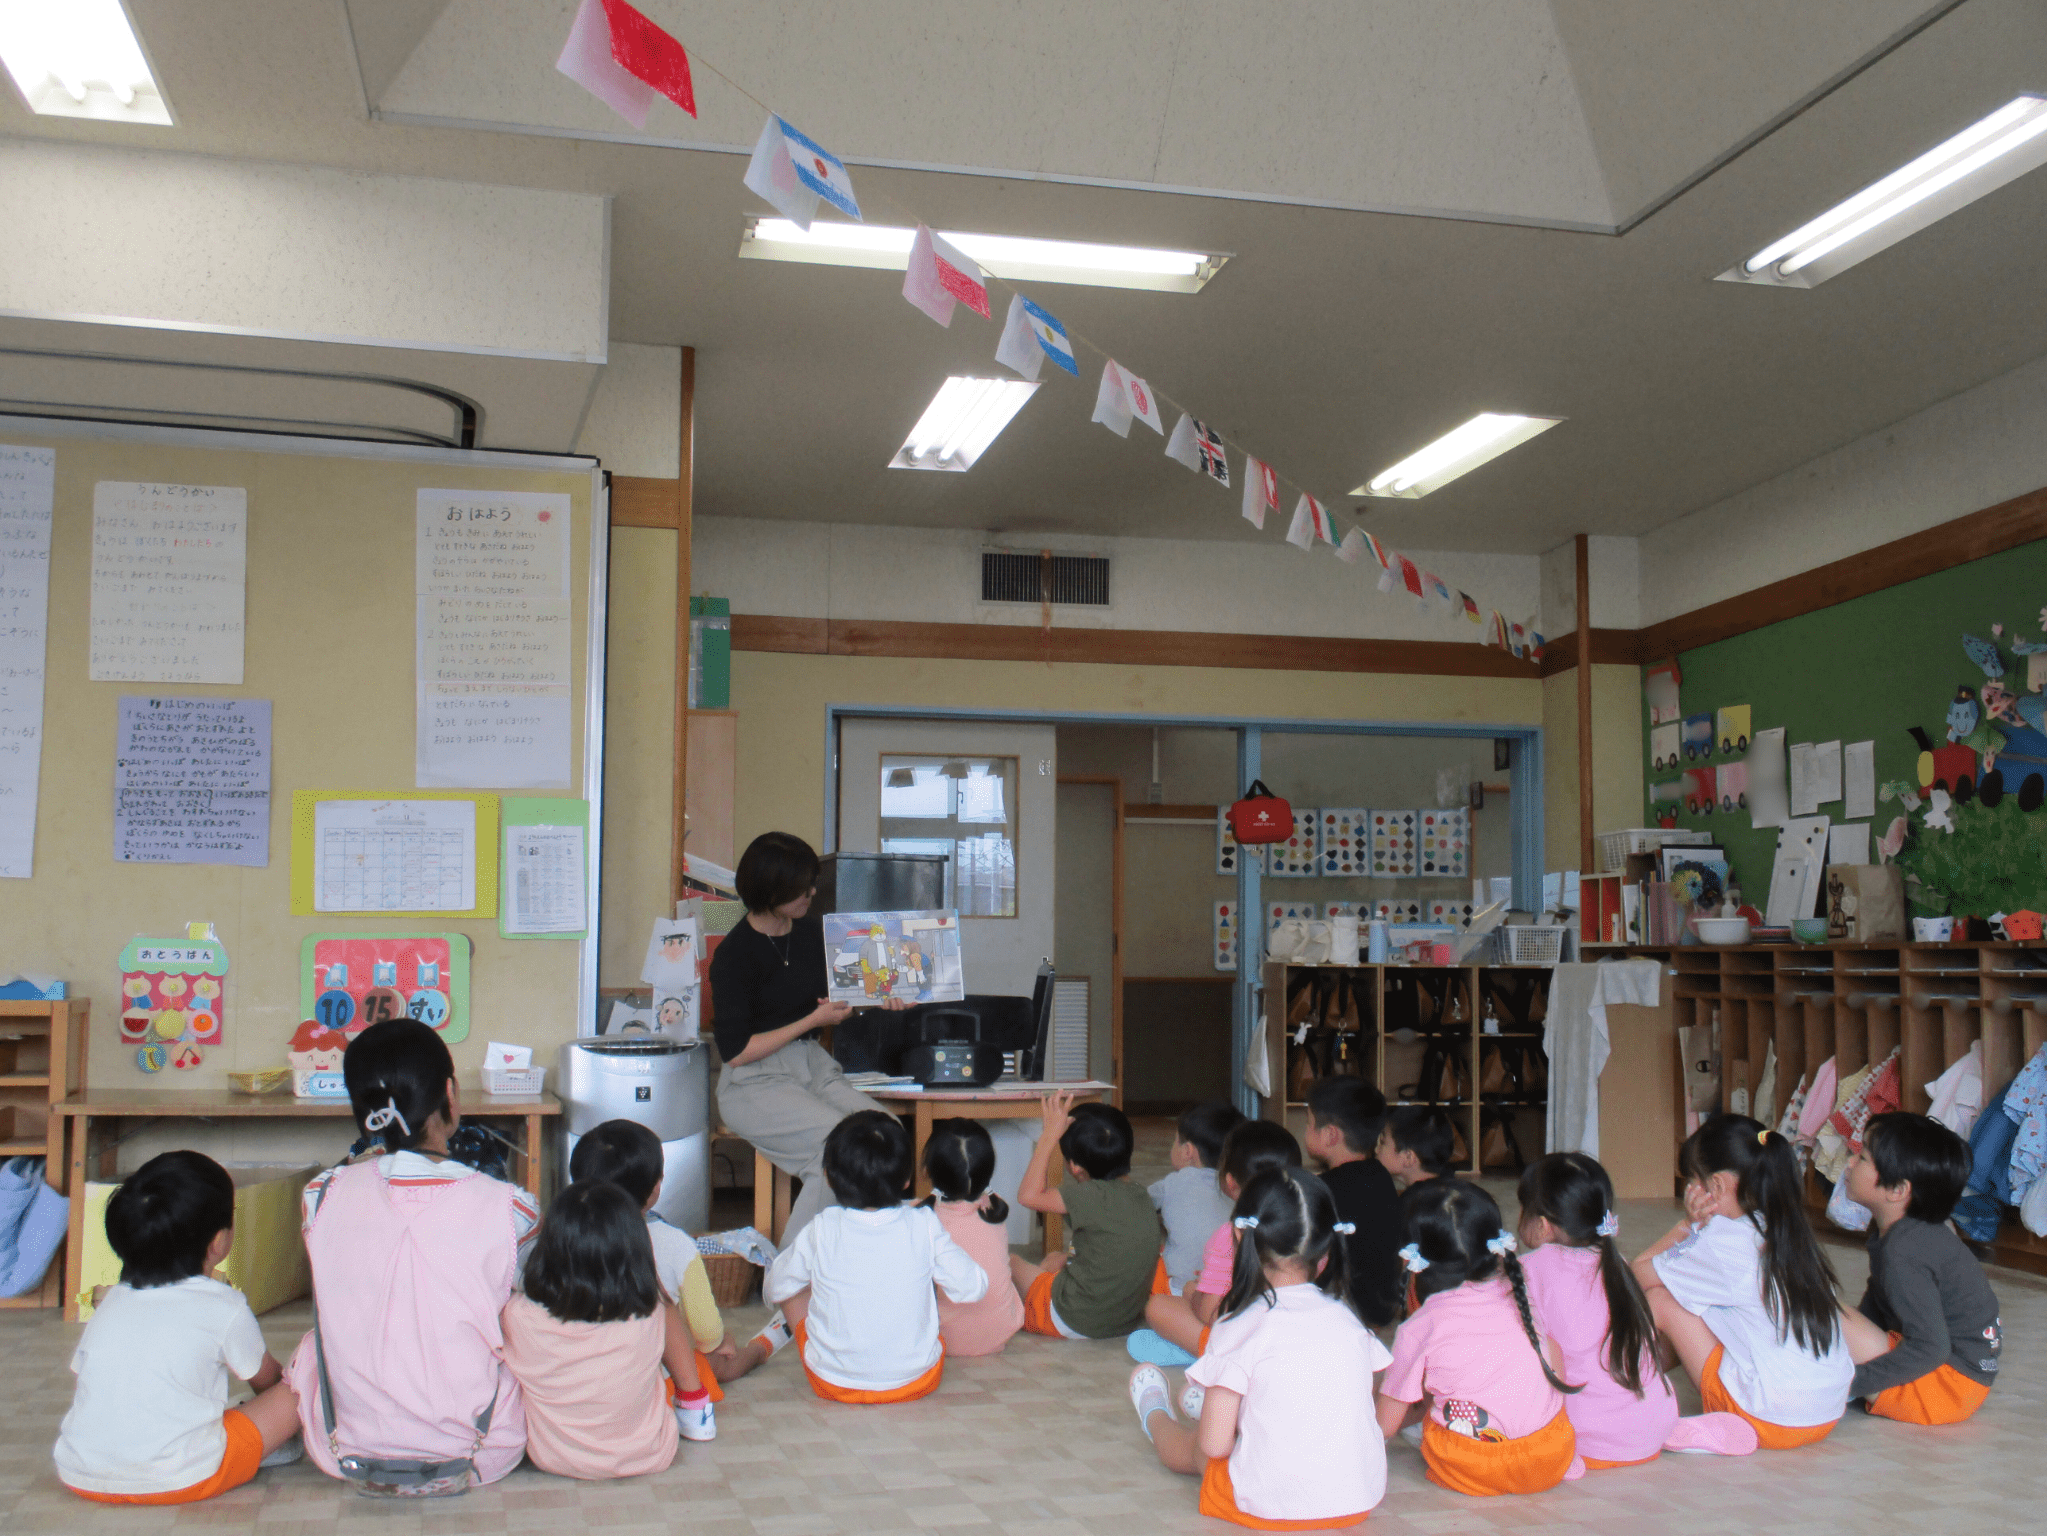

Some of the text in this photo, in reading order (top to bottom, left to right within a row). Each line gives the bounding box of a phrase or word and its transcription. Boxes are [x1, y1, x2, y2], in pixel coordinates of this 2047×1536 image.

[138, 485, 215, 497] うんどうかい
[447, 506, 511, 522] おはよう
[434, 735, 534, 745] おはよう おはよう おはよう
[141, 950, 211, 960] おとうばん
[321, 998, 348, 1026] 10
[365, 996, 392, 1022] 15
[410, 998, 444, 1020] すい
